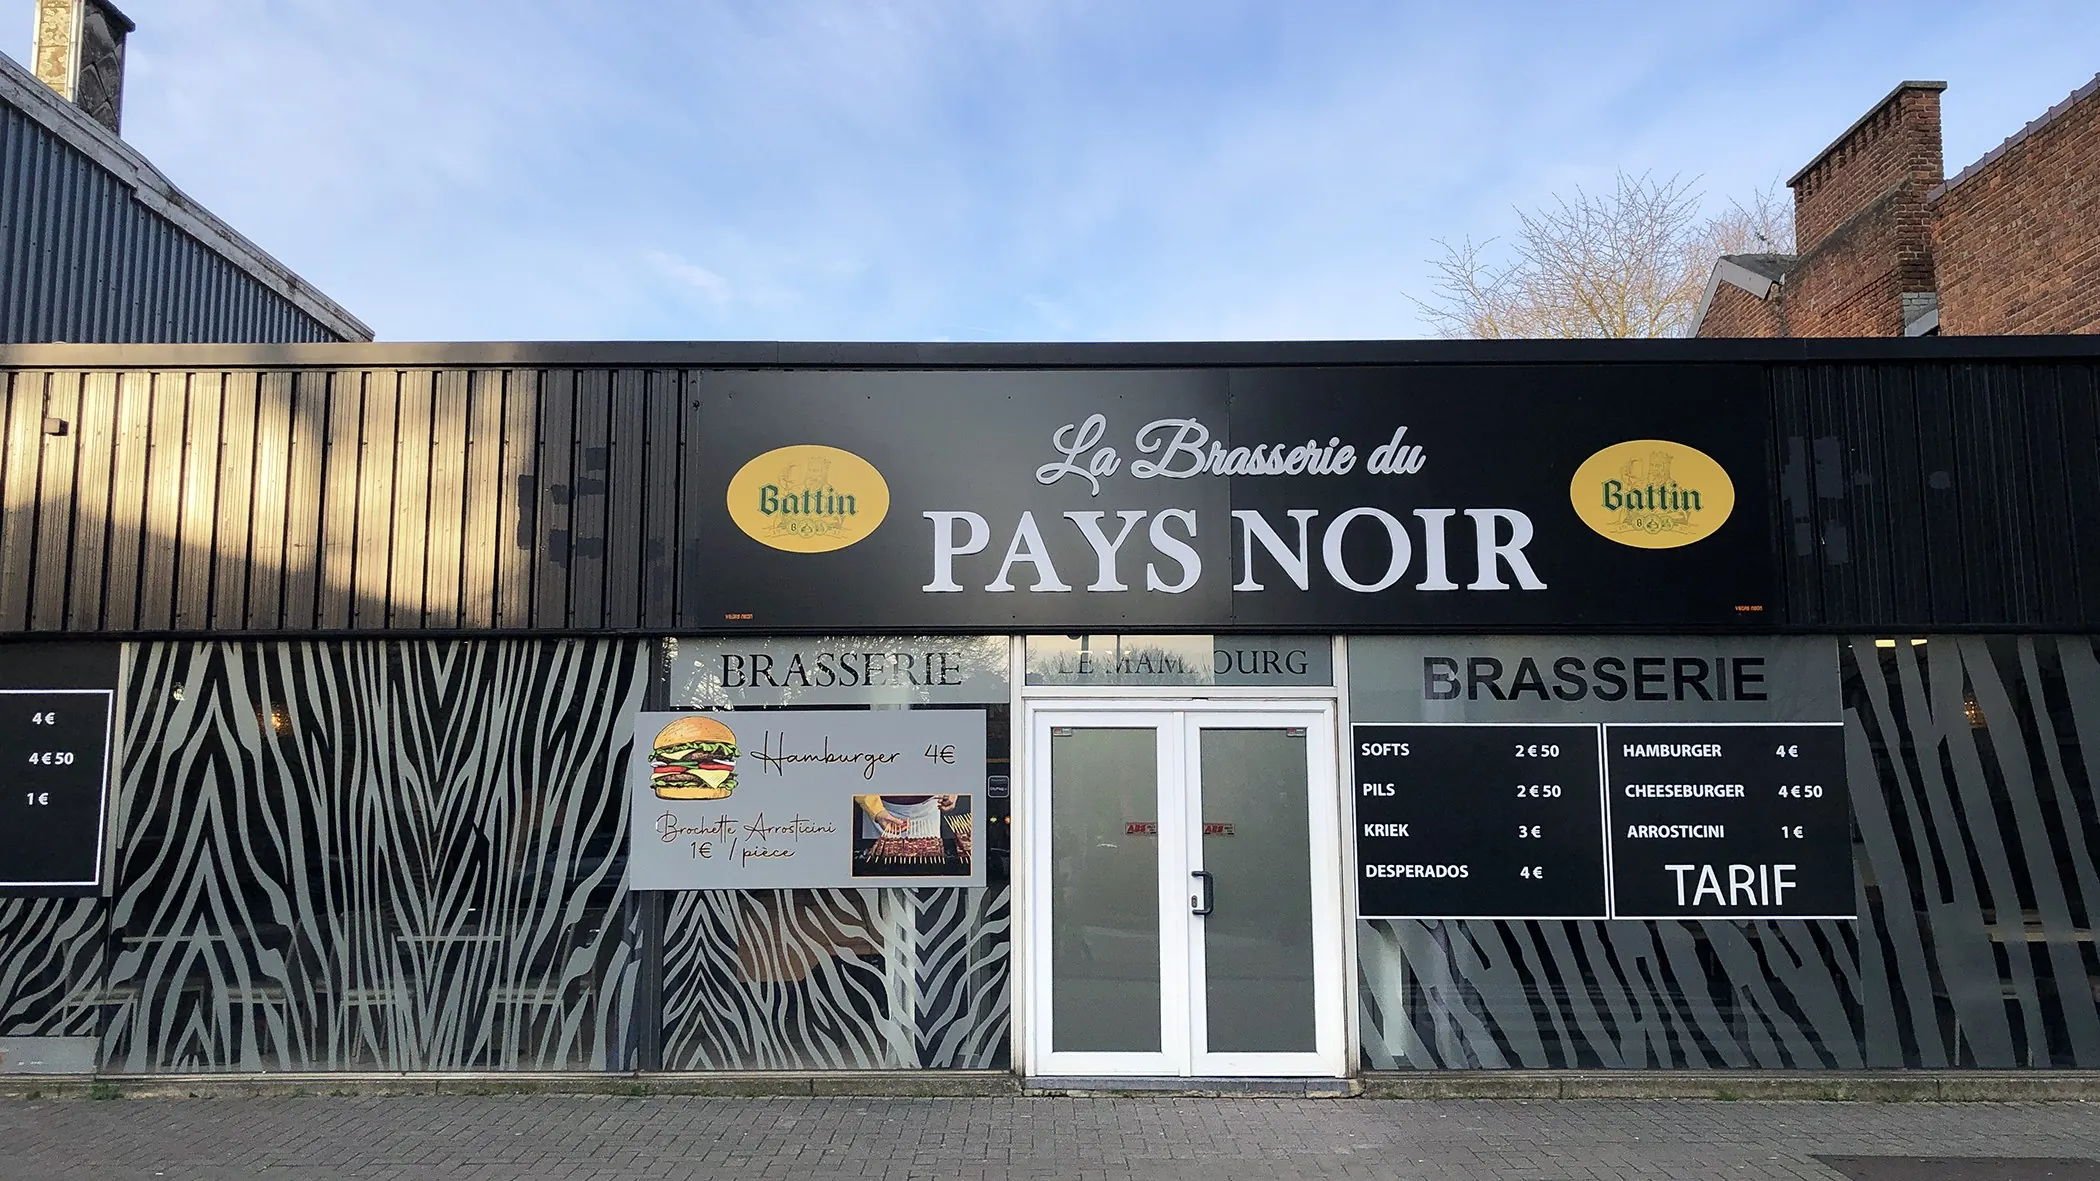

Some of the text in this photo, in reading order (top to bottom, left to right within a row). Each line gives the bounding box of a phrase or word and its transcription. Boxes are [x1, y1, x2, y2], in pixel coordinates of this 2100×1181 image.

[1035, 413, 1427, 497] La Brasserie du
[757, 483, 859, 517] Battin
[1602, 478, 1703, 512] Battin
[922, 507, 1548, 594] PAYS NOIR
[720, 651, 962, 689] BRASSERIE
[1104, 649, 1309, 676] MAMOURG
[1423, 656, 1768, 702] BRASSERIE
[750, 730, 957, 779] Hamburger 4€
[1361, 742, 1410, 757] SOFTS
[1623, 744, 1722, 758] HAMBURGER
[1362, 783, 1396, 797] PILS
[1624, 784, 1745, 798] CHEESEBURGER
[655, 810, 837, 844] Brochette Arrosticini
[1364, 823, 1410, 837] KRIEK
[1627, 824, 1725, 839] ARROSTICINI
[690, 841, 714, 860] 1€
[1365, 864, 1469, 879] DESPERADOS
[1664, 864, 1797, 906] TARIF
